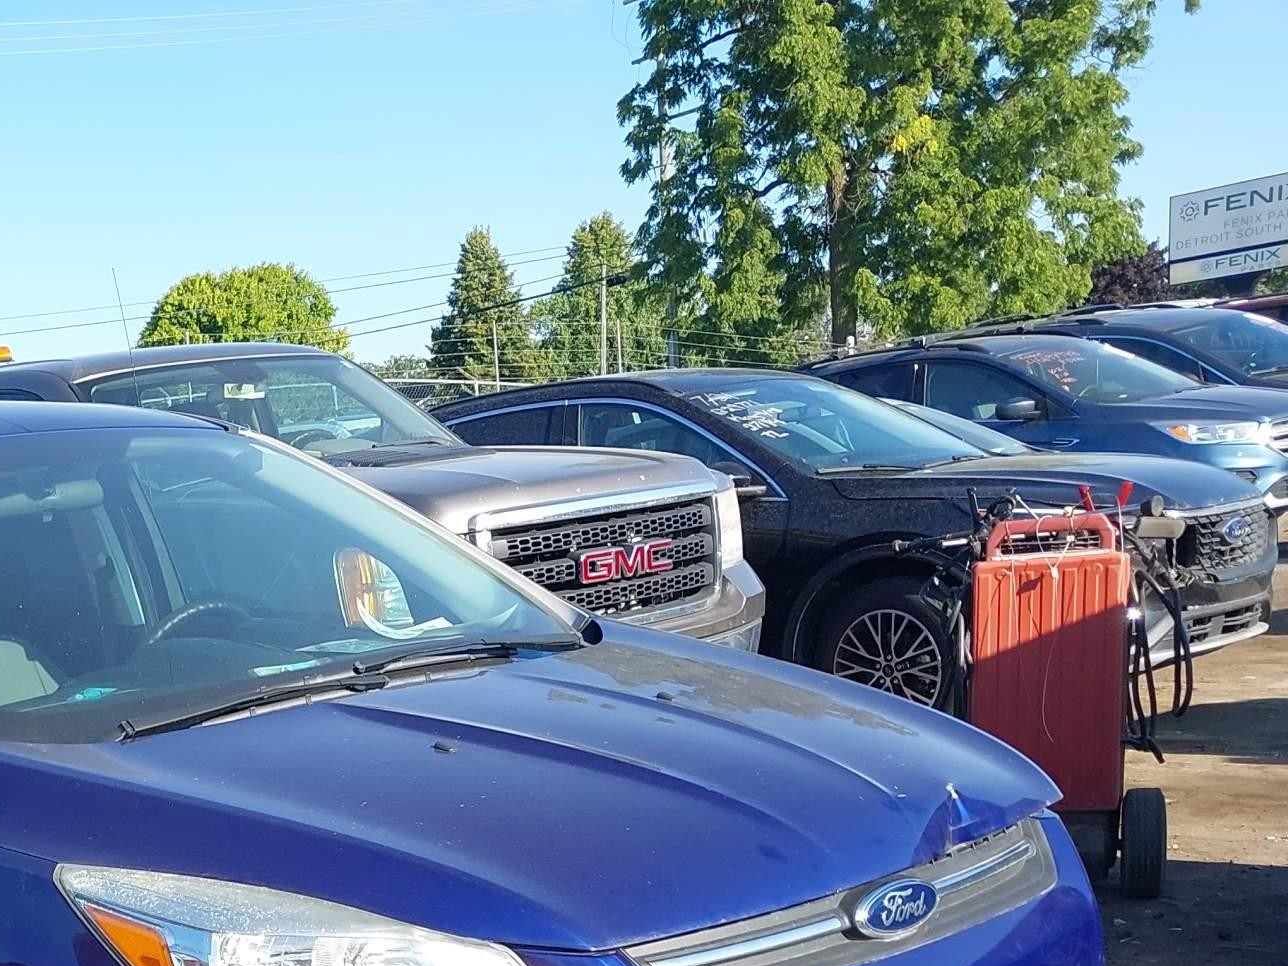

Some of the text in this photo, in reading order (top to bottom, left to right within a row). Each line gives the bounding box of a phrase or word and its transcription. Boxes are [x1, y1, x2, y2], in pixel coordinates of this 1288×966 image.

[1203, 184, 1288, 216] FENI
[1223, 214, 1262, 229] FENIX
[1176, 223, 1282, 250] DETROIT SOUTH
[1215, 247, 1281, 269] FENIX
[580, 539, 673, 584] GMC
[881, 888, 927, 927] Ford
